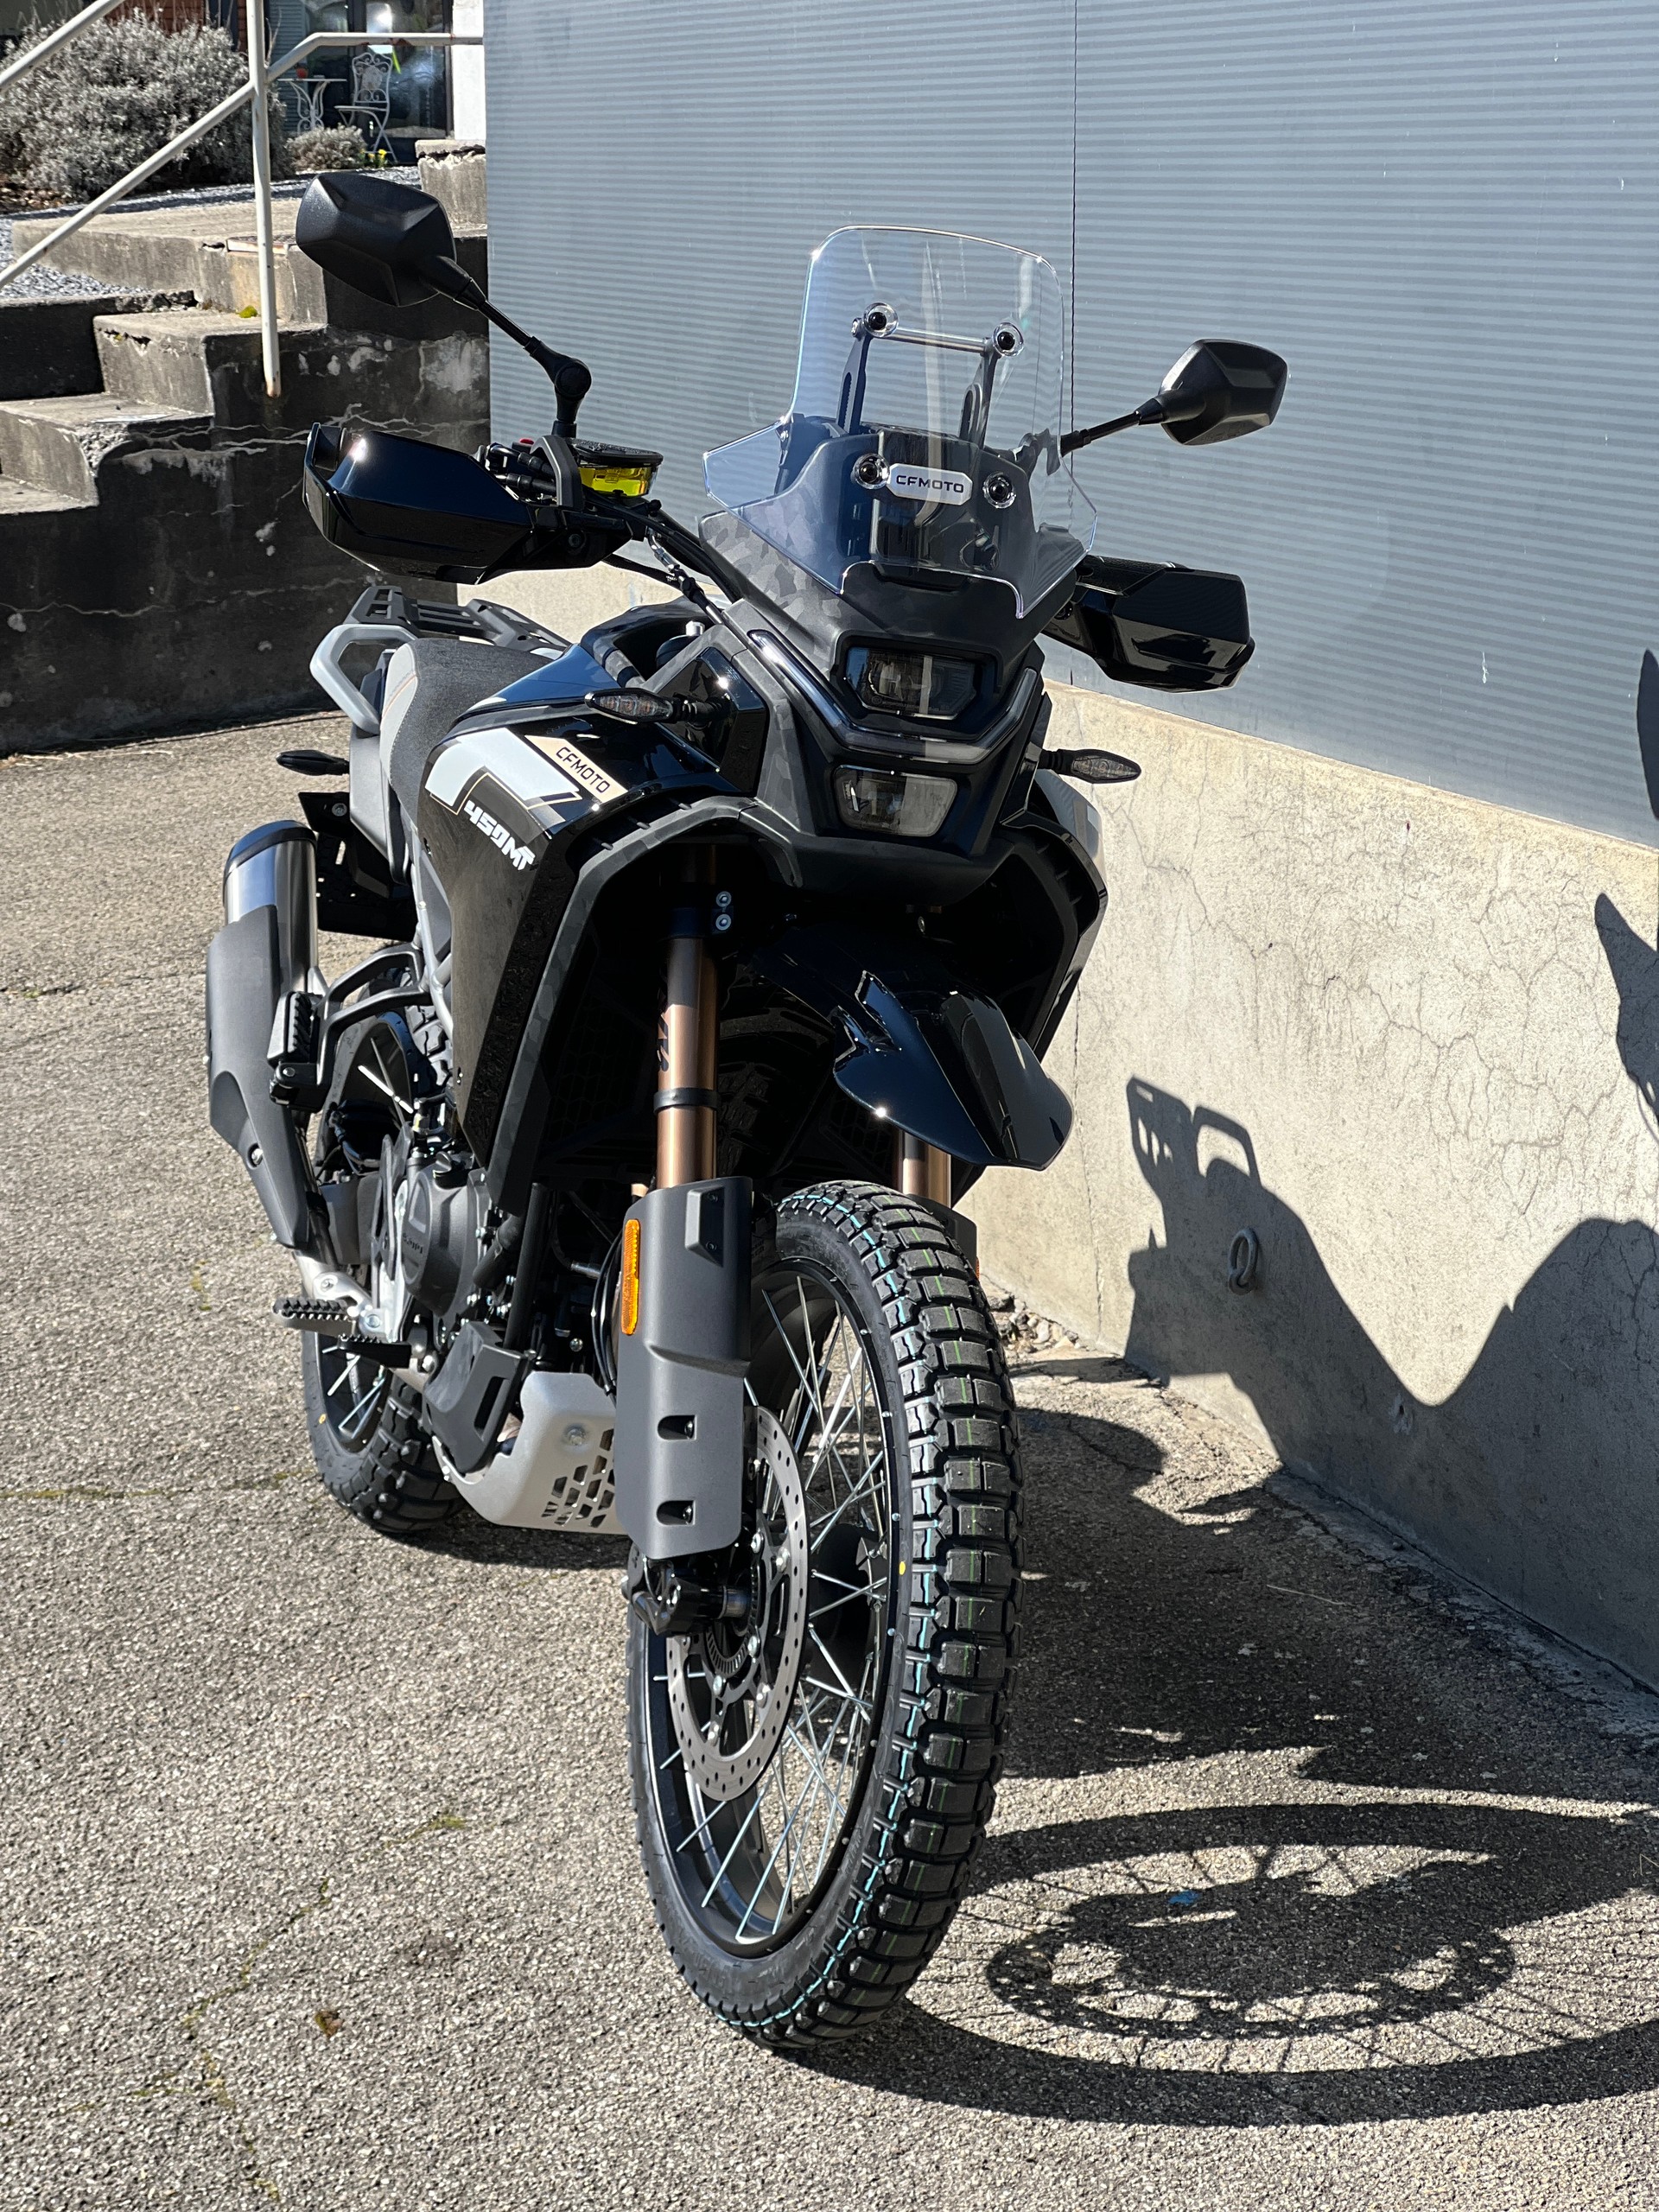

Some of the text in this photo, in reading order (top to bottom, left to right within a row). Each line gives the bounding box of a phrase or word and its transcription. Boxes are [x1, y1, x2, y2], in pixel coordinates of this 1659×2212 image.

[896, 475, 964, 493] CFMOTO
[556, 747, 611, 793] CFMOTO
[463, 799, 536, 871] 450MT
